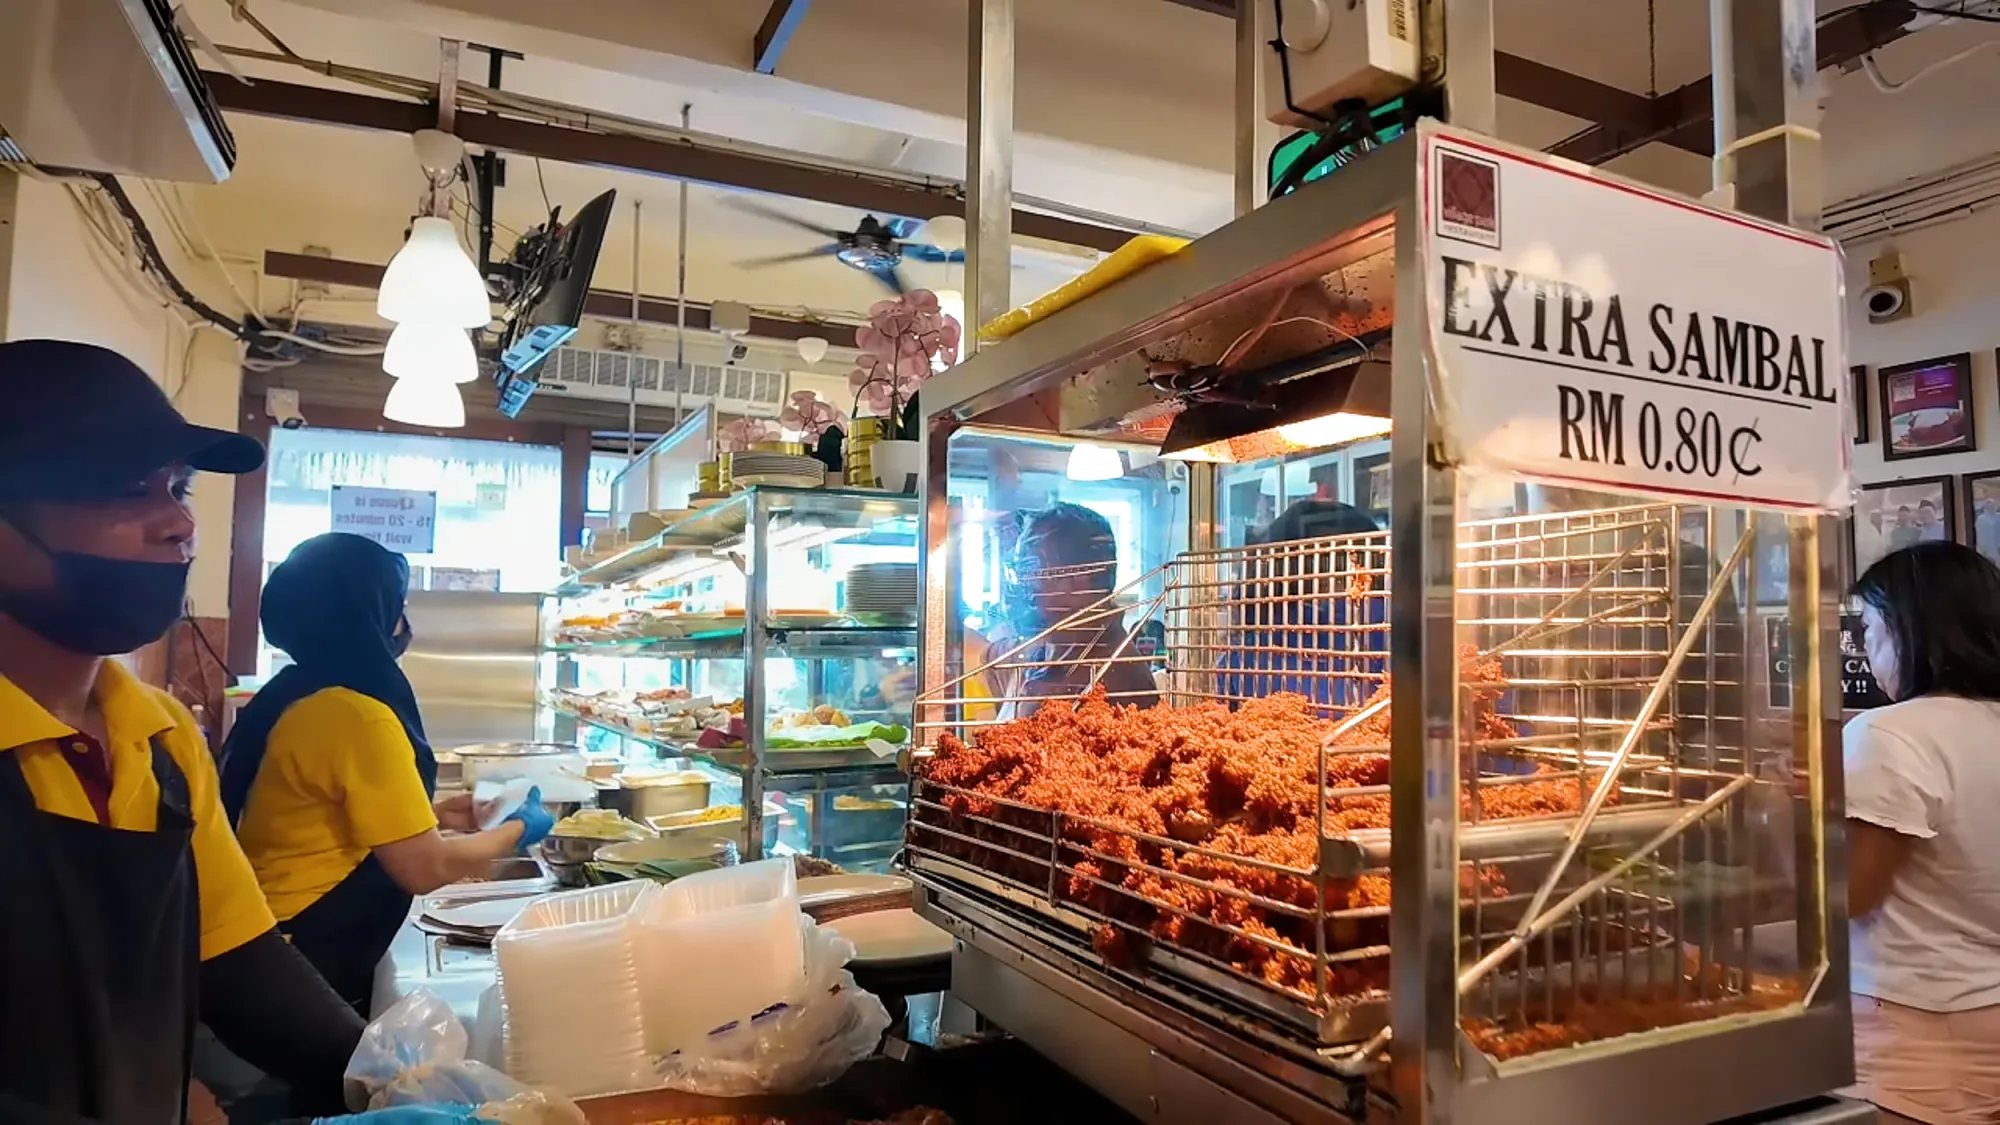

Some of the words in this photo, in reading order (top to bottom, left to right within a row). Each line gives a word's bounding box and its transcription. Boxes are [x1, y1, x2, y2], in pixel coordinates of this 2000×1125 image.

[1441, 256, 1633, 367] EXTRA
[1649, 303, 1836, 403] SAMBAL
[1557, 384, 1626, 466] RM
